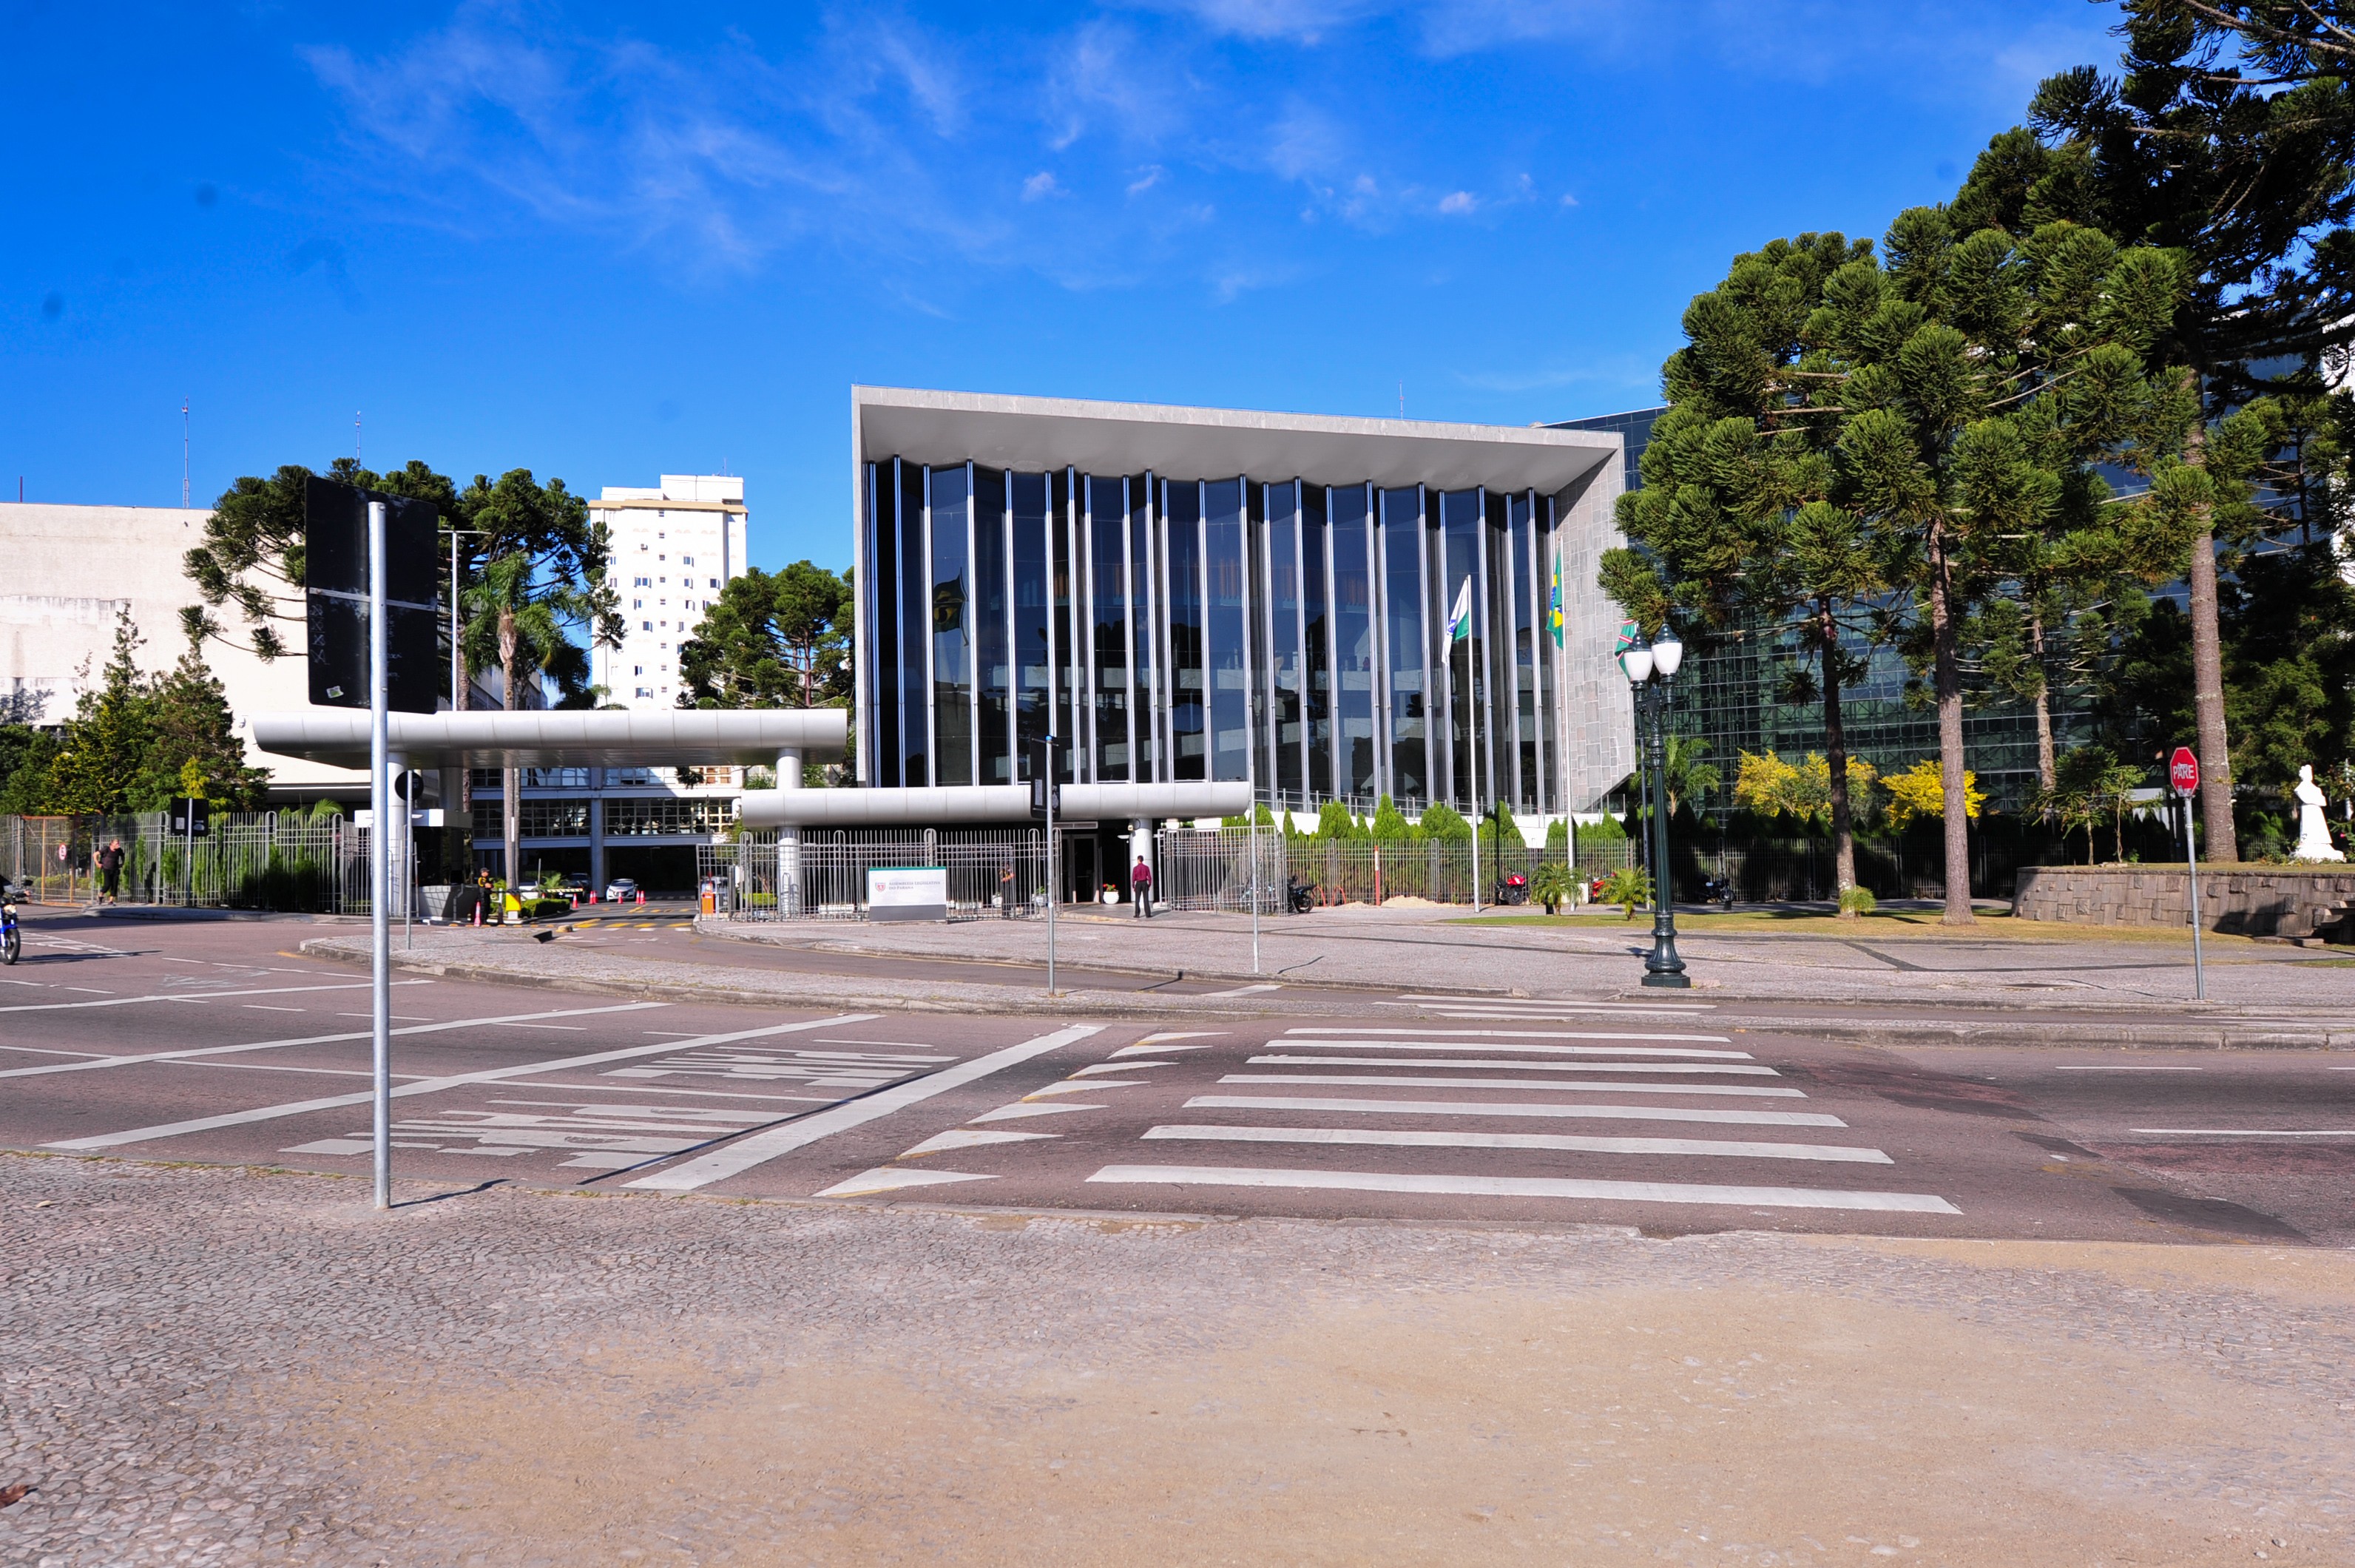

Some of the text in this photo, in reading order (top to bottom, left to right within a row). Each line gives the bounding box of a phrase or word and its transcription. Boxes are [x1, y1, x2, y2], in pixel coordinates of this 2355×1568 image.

[2173, 765, 2194, 780] PARE
[597, 1046, 961, 1088] PARE
[277, 1099, 801, 1170] PARE
